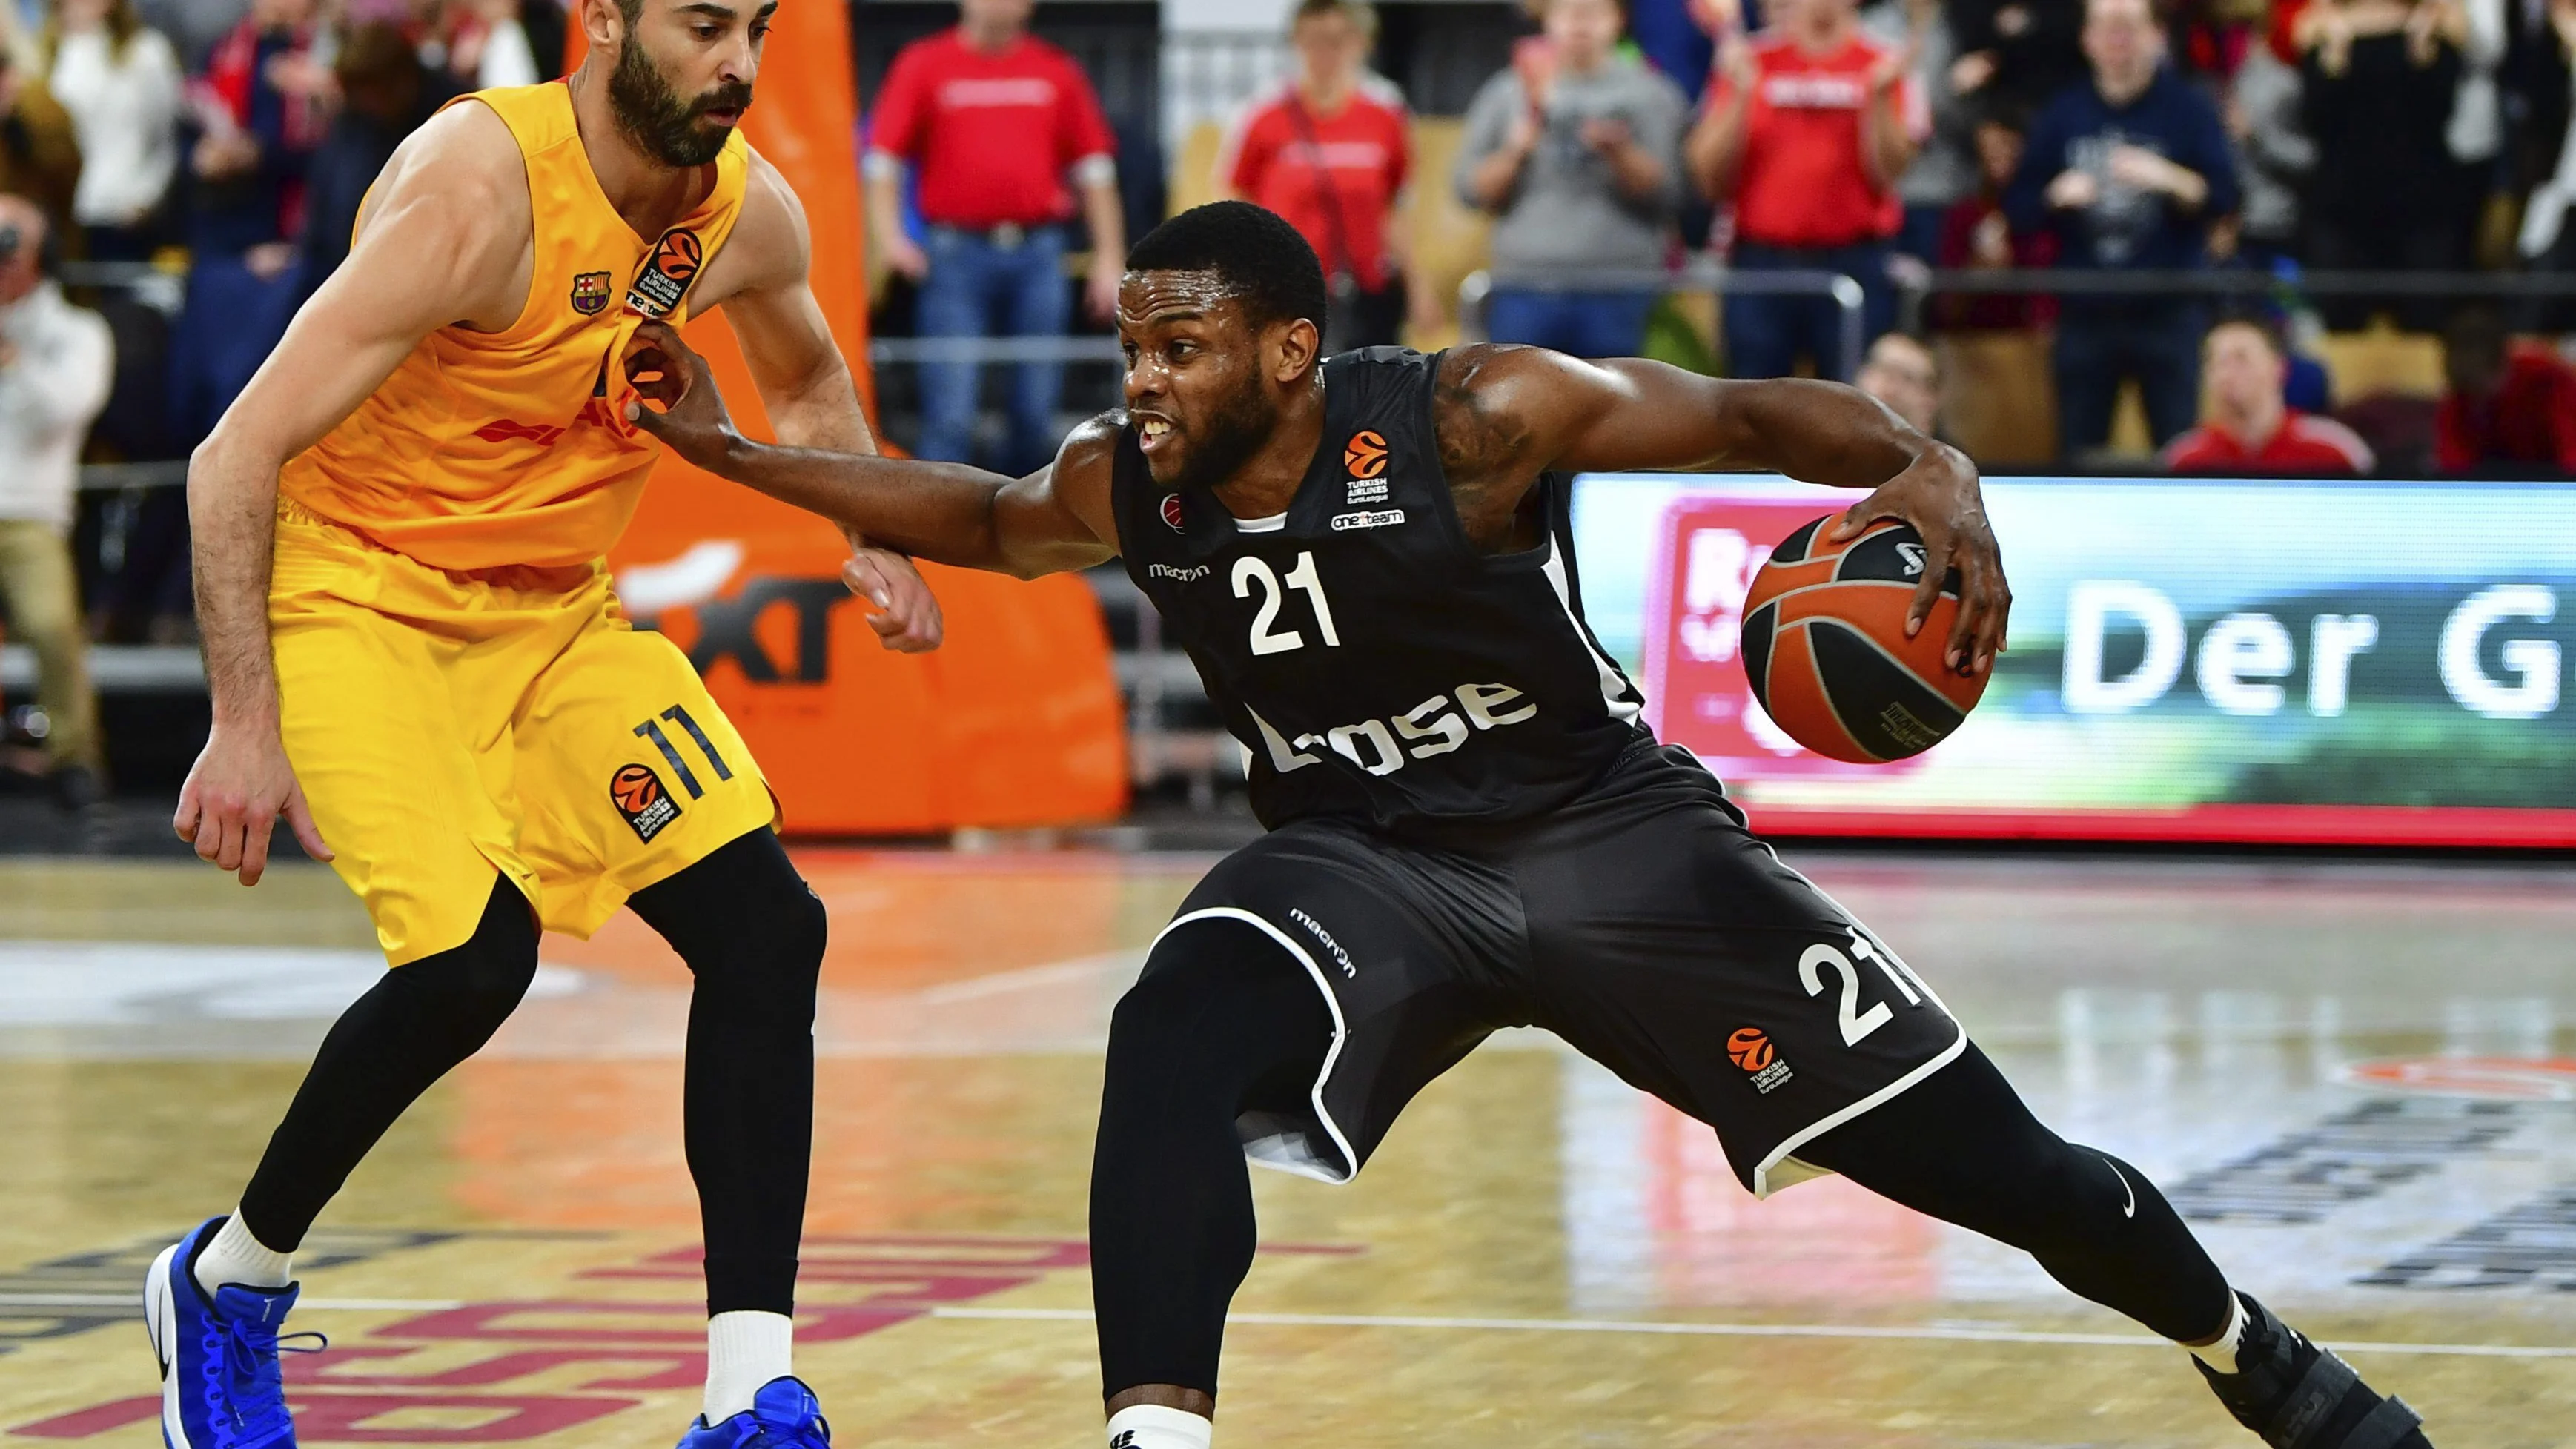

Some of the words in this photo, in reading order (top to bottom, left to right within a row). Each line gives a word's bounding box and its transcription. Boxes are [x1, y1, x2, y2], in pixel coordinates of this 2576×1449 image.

[643, 275, 678, 300] AIRLINES
[649, 268, 681, 294] TURKISH
[1346, 477, 1387, 489] TURKISH
[1347, 485, 1388, 497] AIRLINES
[1347, 494, 1388, 505] EuroLeague
[1231, 551, 1340, 656] 21
[2062, 580, 2379, 717] Der
[2437, 584, 2576, 720] G
[632, 703, 734, 800] 11
[632, 795, 667, 826] TURKISH
[1290, 907, 1357, 979] macron
[1798, 926, 1921, 1047] 21
[1749, 1058, 1785, 1084] TURKISH
[1756, 1065, 1789, 1090] AIRLINES
